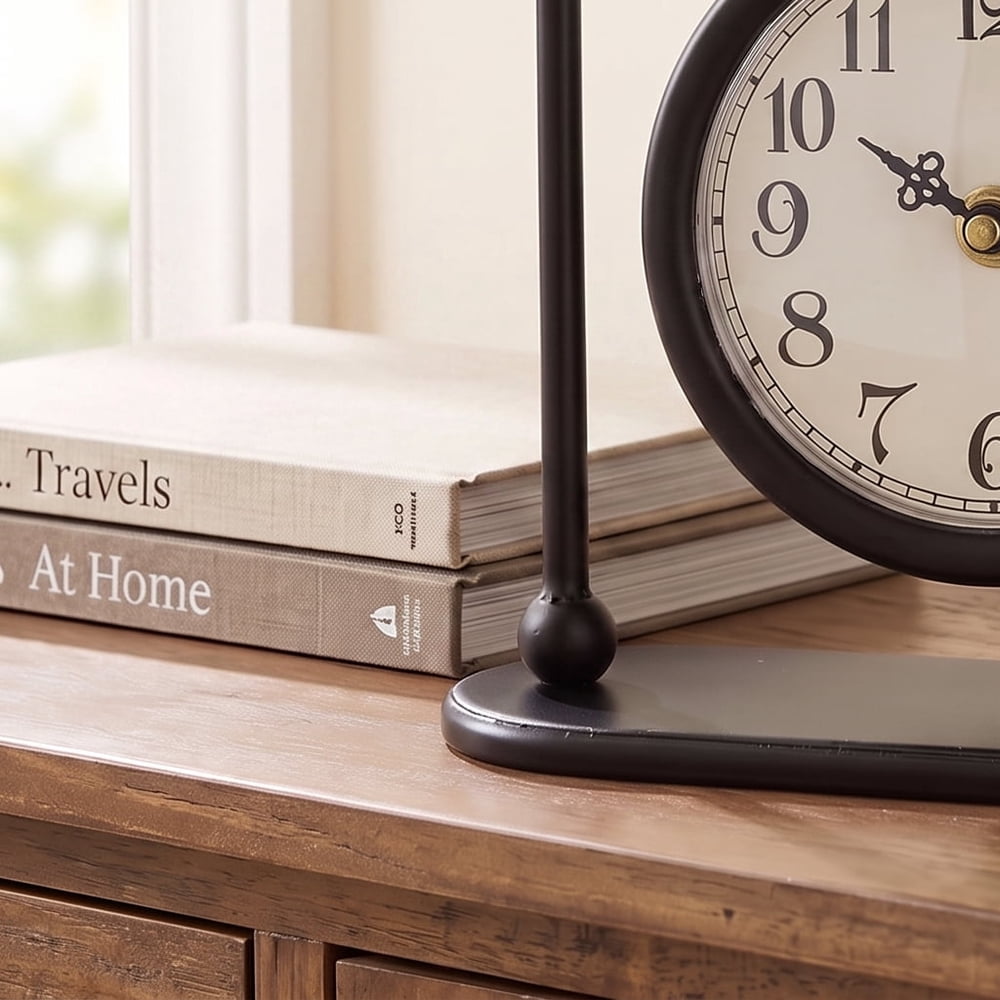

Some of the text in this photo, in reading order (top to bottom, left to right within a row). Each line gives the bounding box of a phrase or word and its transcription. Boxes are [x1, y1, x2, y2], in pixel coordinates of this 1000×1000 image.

[763, 77, 836, 153] 10
[752, 180, 809, 258] 9
[778, 291, 834, 368] 8
[857, 382, 918, 465] 7
[26, 447, 171, 510] Travels
[29, 544, 212, 616] At Home
